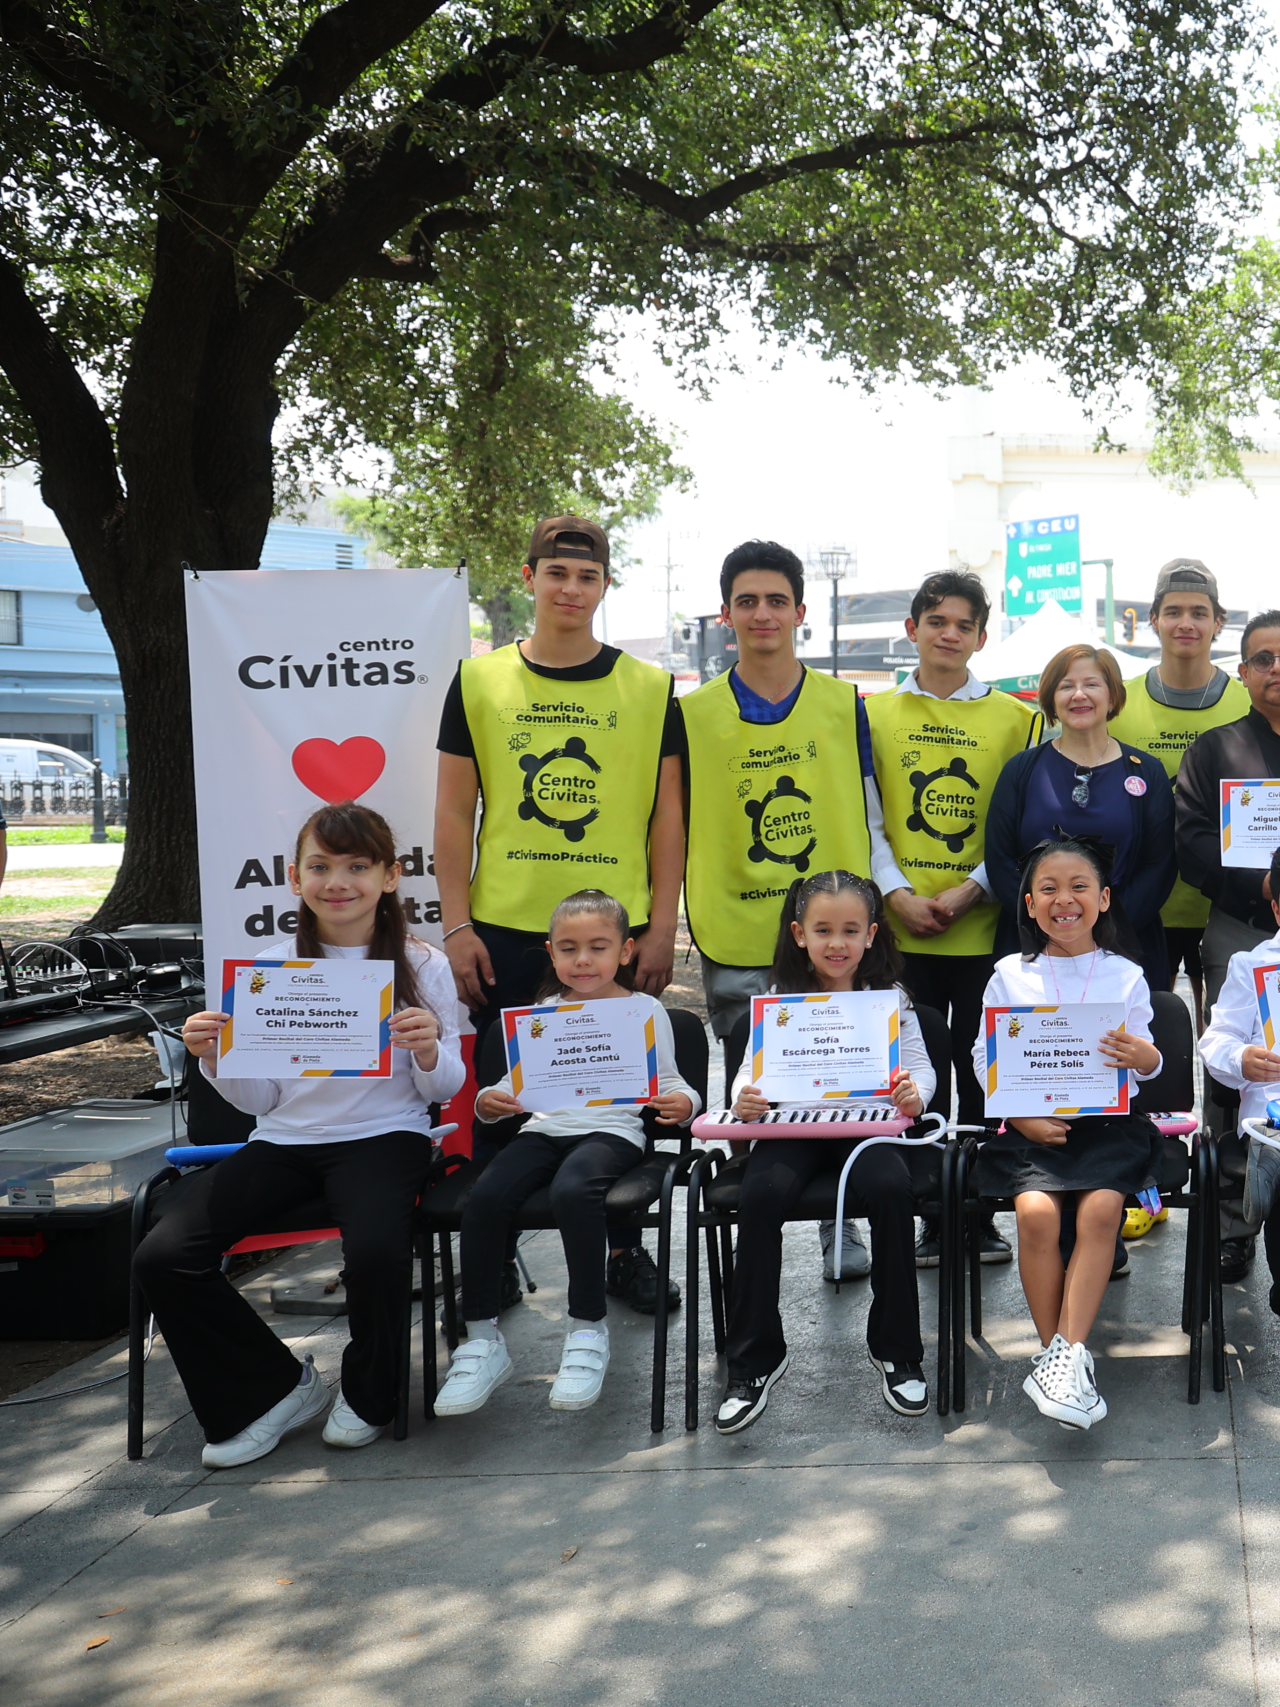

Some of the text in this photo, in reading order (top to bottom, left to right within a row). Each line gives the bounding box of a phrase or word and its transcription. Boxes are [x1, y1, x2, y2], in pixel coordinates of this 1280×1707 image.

[1037, 518, 1076, 534] CEU
[1027, 562, 1077, 578] PADRE MIER
[339, 638, 414, 652] centro
[883, 656, 903, 664] POLICÍA
[532, 702, 584, 713] Servicio
[516, 713, 598, 726] comunitario
[922, 724, 966, 736] Servicio
[908, 734, 978, 747] comunitario
[539, 773, 596, 789] Centro
[926, 789, 975, 805] Centro
[763, 810, 810, 828] Centro
[507, 850, 618, 865] #CivismoPráctico
[244, 905, 299, 938] de
[256, 1007, 358, 1017] Catalina Sánchez
[266, 1020, 348, 1029] Chi Pebworth
[554, 1033, 612, 1042] RECONOCIMIENTO
[814, 1036, 840, 1044] Sofía
[557, 1044, 611, 1056] Jade Sofía
[782, 1046, 871, 1056] Escárcega Torres
[1023, 1049, 1090, 1058] María Rebeca
[550, 1053, 620, 1067] Acosta Cantú
[1030, 1060, 1085, 1069] Pérez Solís
